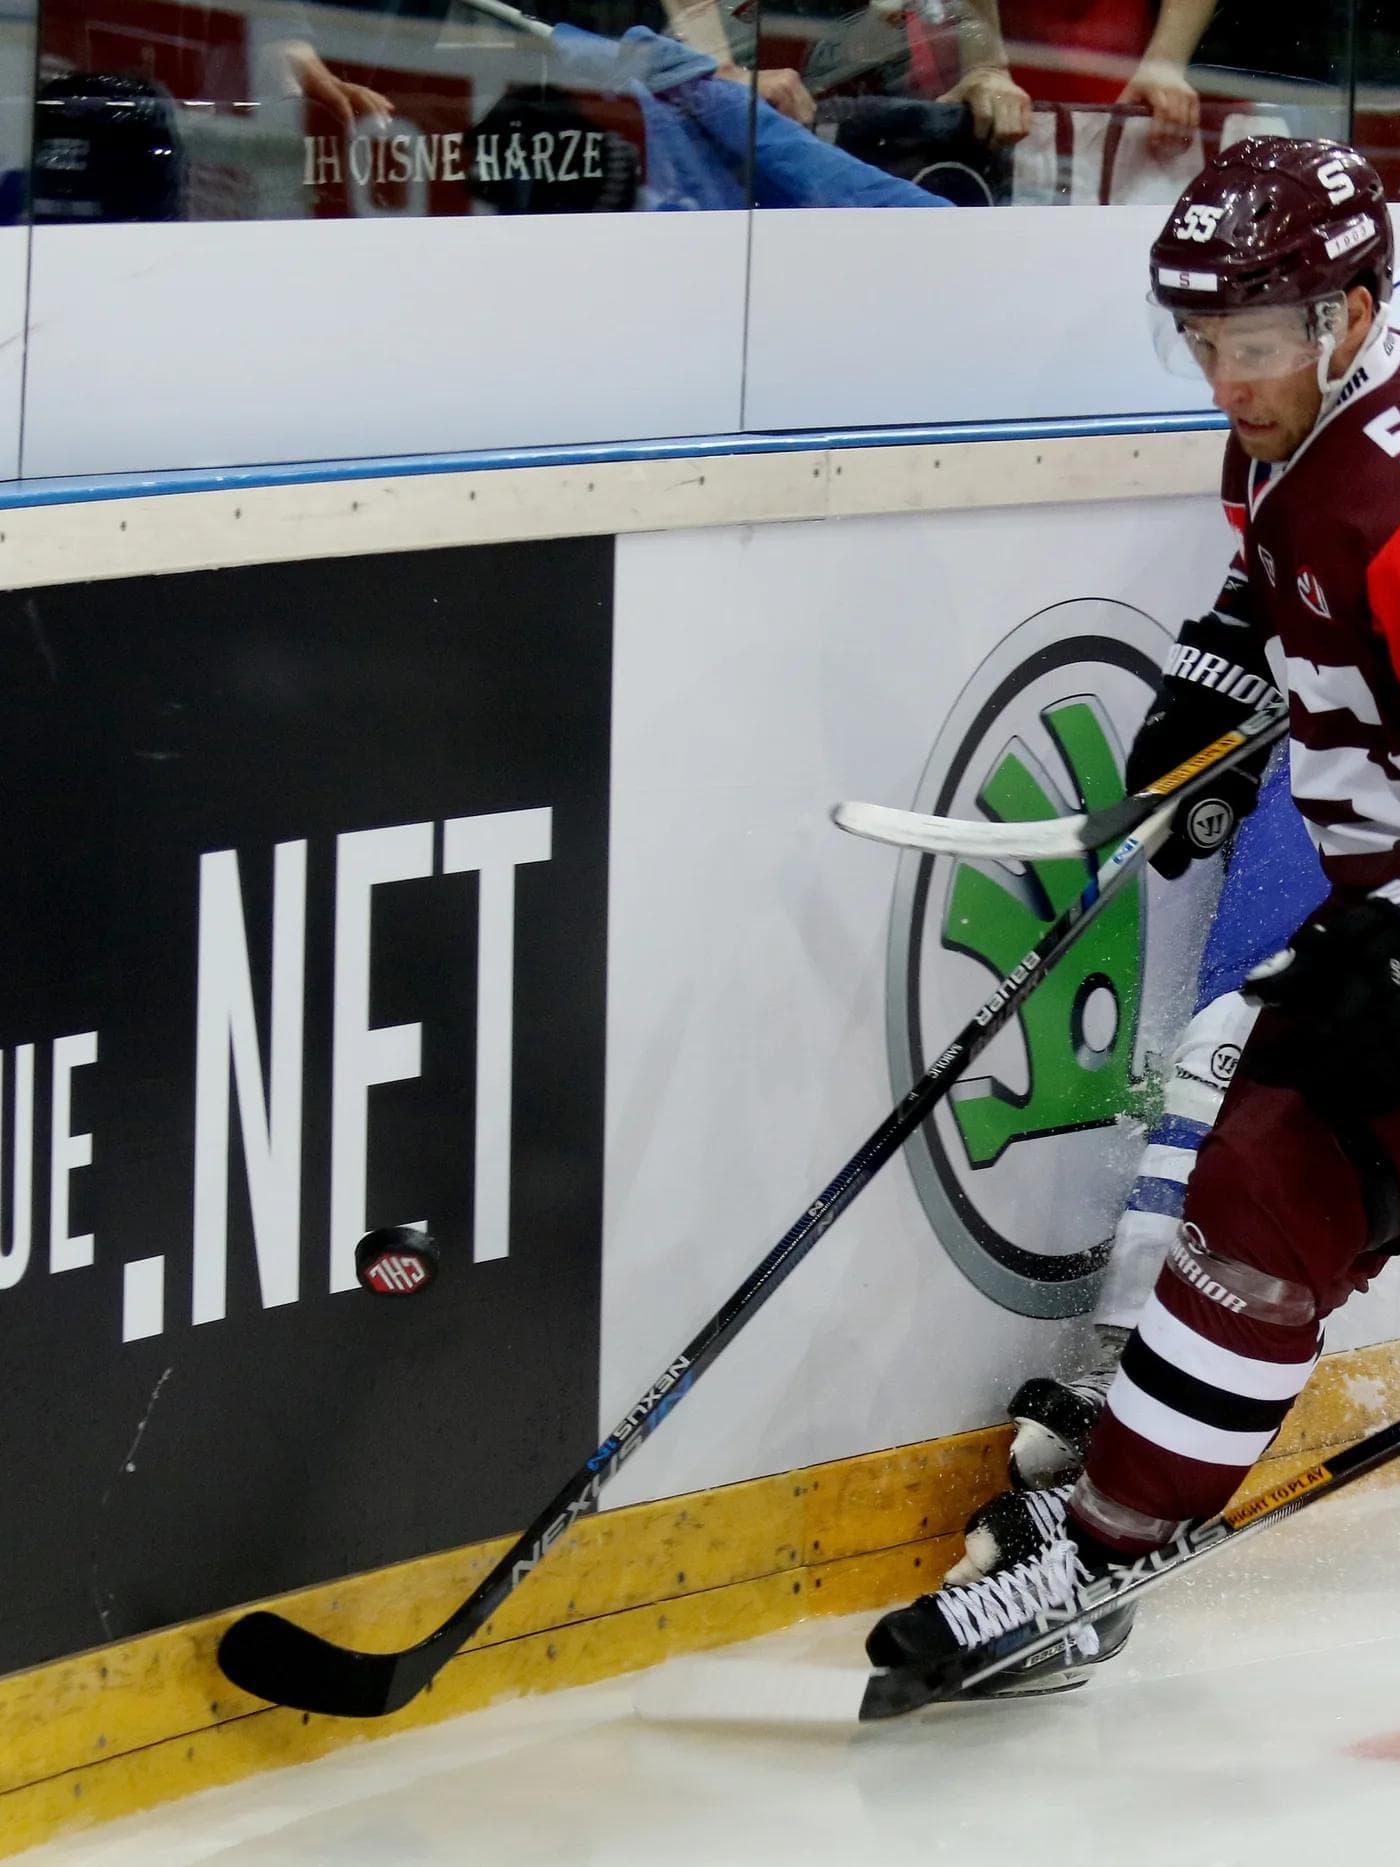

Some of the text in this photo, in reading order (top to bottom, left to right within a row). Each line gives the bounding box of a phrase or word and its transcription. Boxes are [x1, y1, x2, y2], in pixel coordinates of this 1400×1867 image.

[476, 120, 604, 183] HÄRZE
[1317, 159, 1356, 206] S
[1175, 203, 1225, 243] 55
[975, 949, 1042, 1028] BAUER
[613, 1354, 692, 1442] NEXUS
[511, 1428, 646, 1591] NEXUS
[1288, 1465, 1325, 1500] PLAY
